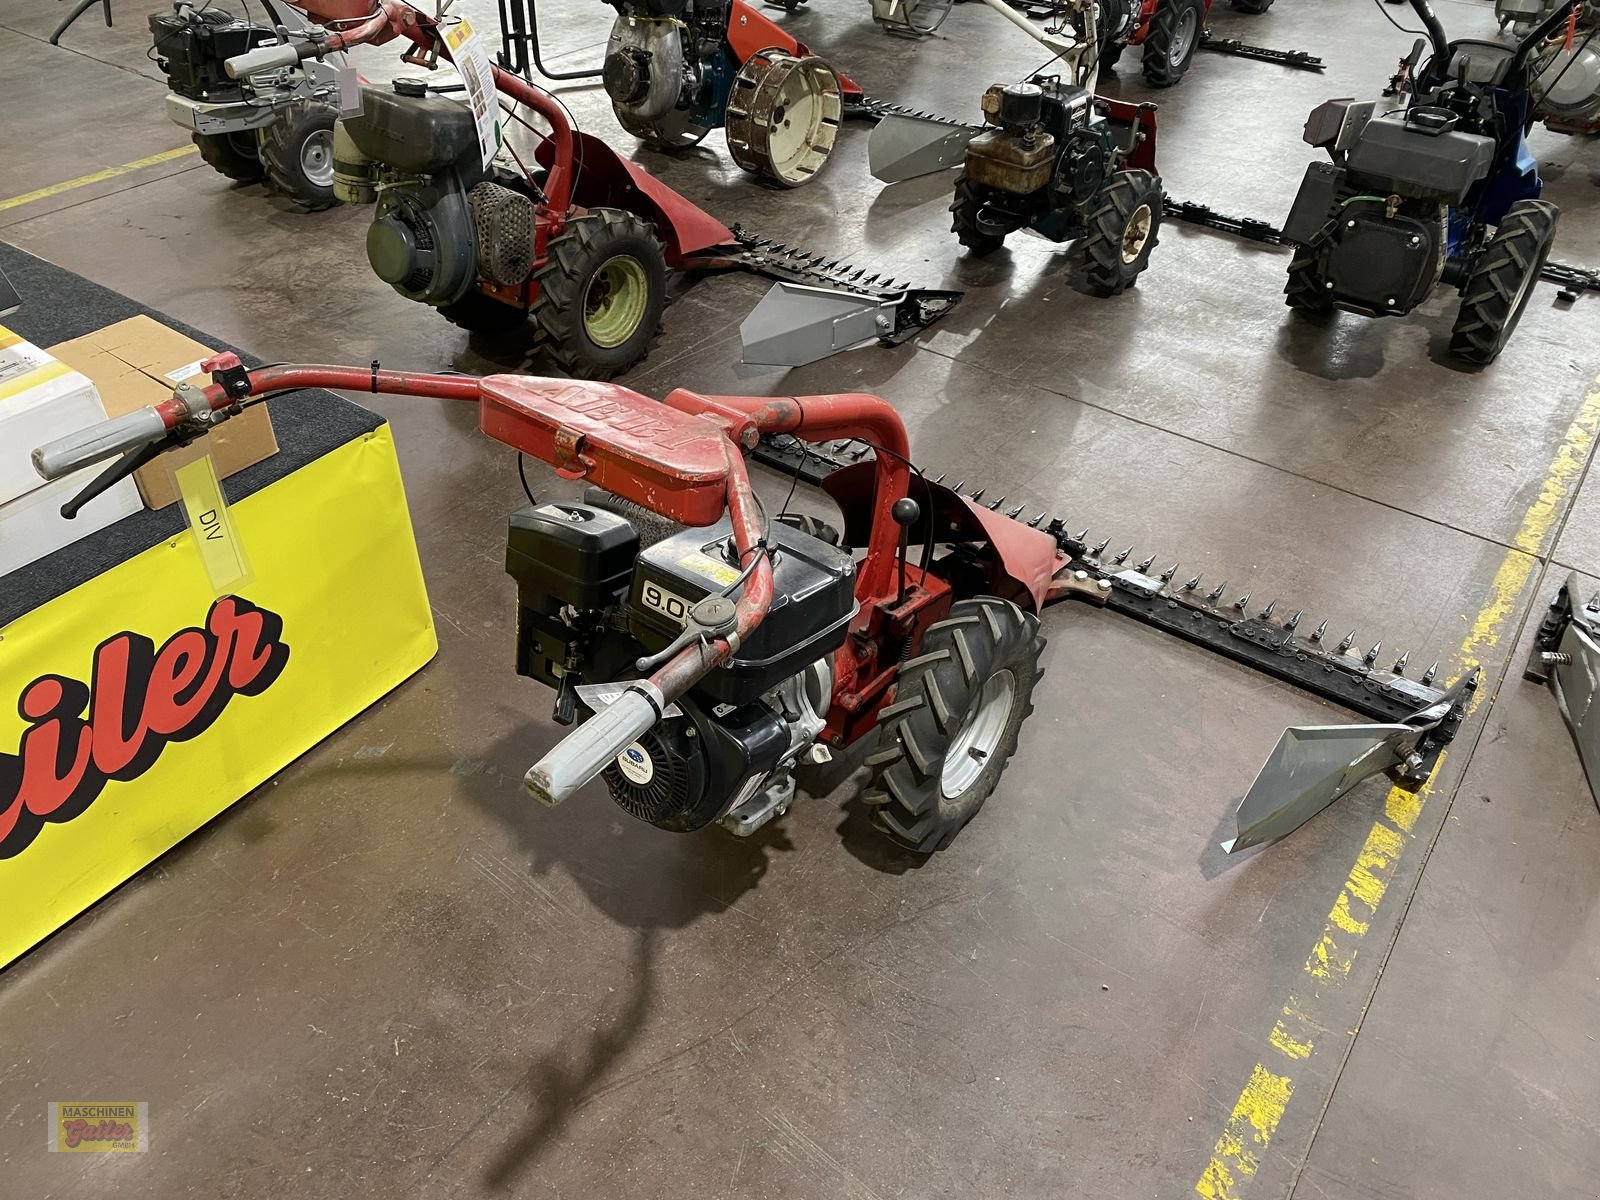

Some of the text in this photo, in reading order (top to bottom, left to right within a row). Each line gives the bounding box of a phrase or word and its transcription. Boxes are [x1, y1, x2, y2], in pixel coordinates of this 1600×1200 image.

[525, 384, 707, 451] AEBI
[199, 508, 224, 541] DIV
[0, 596, 290, 858] iler
[622, 755, 648, 774] SUBARU
